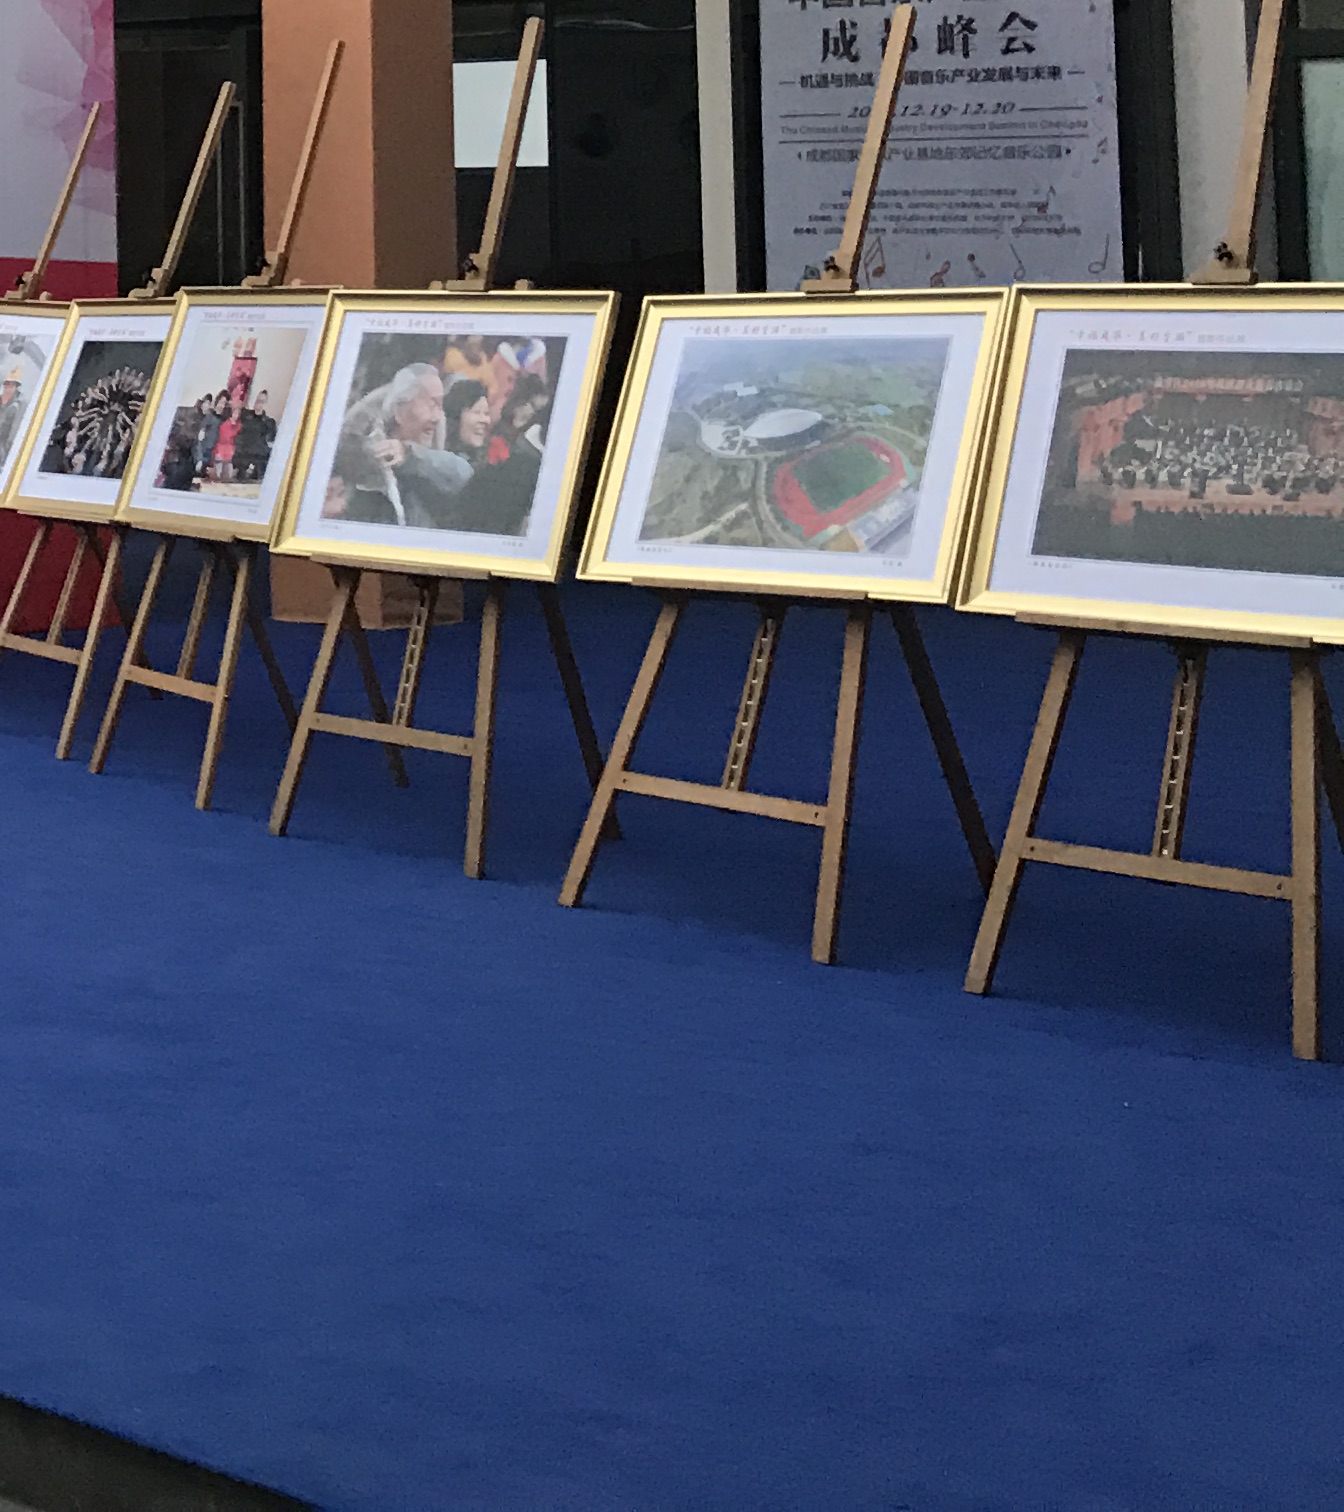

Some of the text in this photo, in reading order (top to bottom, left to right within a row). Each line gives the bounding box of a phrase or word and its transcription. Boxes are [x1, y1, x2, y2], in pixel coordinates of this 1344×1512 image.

[821, 11, 1039, 63] 成峰会
[847, 101, 1017, 119] 20.12.19-12.20
